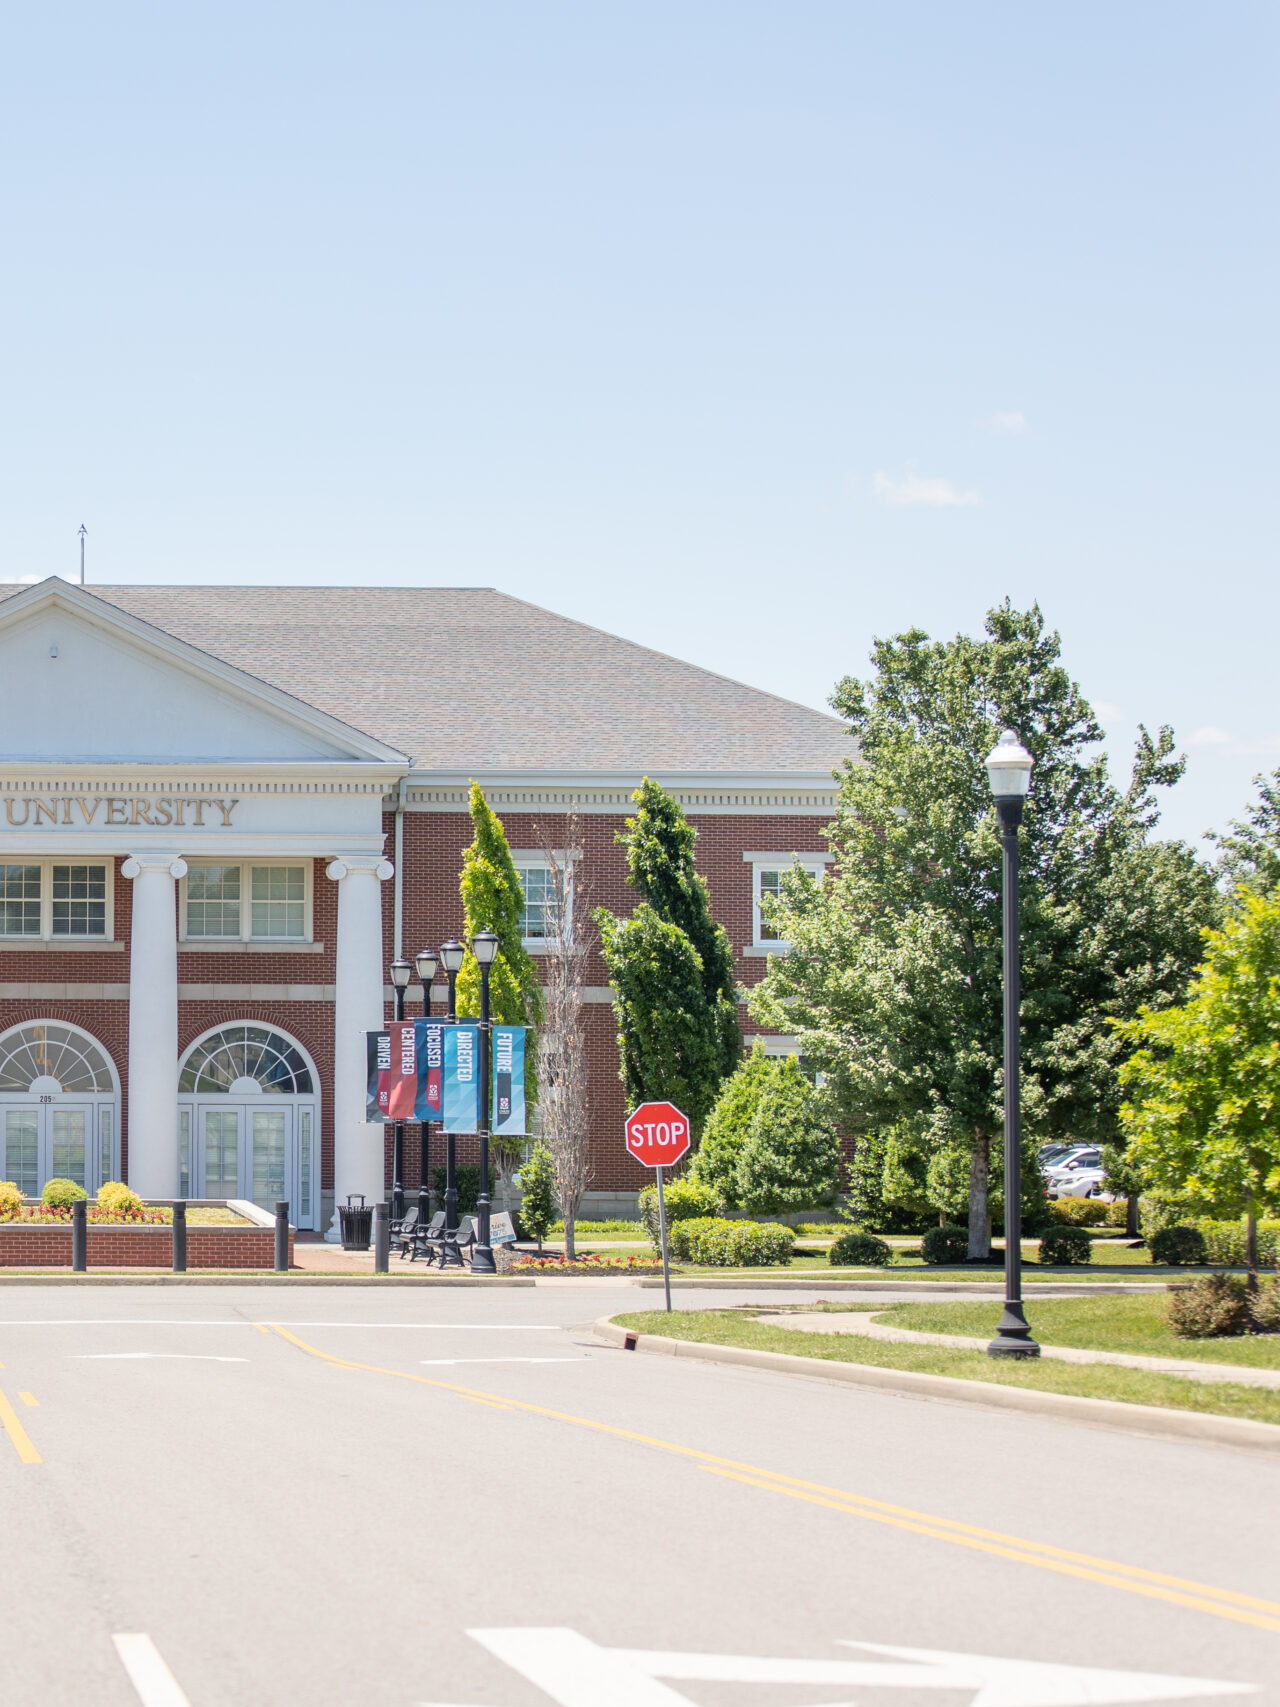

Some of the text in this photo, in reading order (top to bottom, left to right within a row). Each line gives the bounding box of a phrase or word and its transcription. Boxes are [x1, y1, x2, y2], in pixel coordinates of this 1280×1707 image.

[4, 797, 239, 827] UNIVERSITY
[377, 1036, 391, 1069] DRIVEN
[401, 1027, 415, 1075] CENTERED
[426, 1024, 441, 1067] FOCUSED
[457, 1031, 473, 1082] DIRECTED
[497, 1033, 512, 1072] FUTURE
[631, 1122, 684, 1147] STOP
